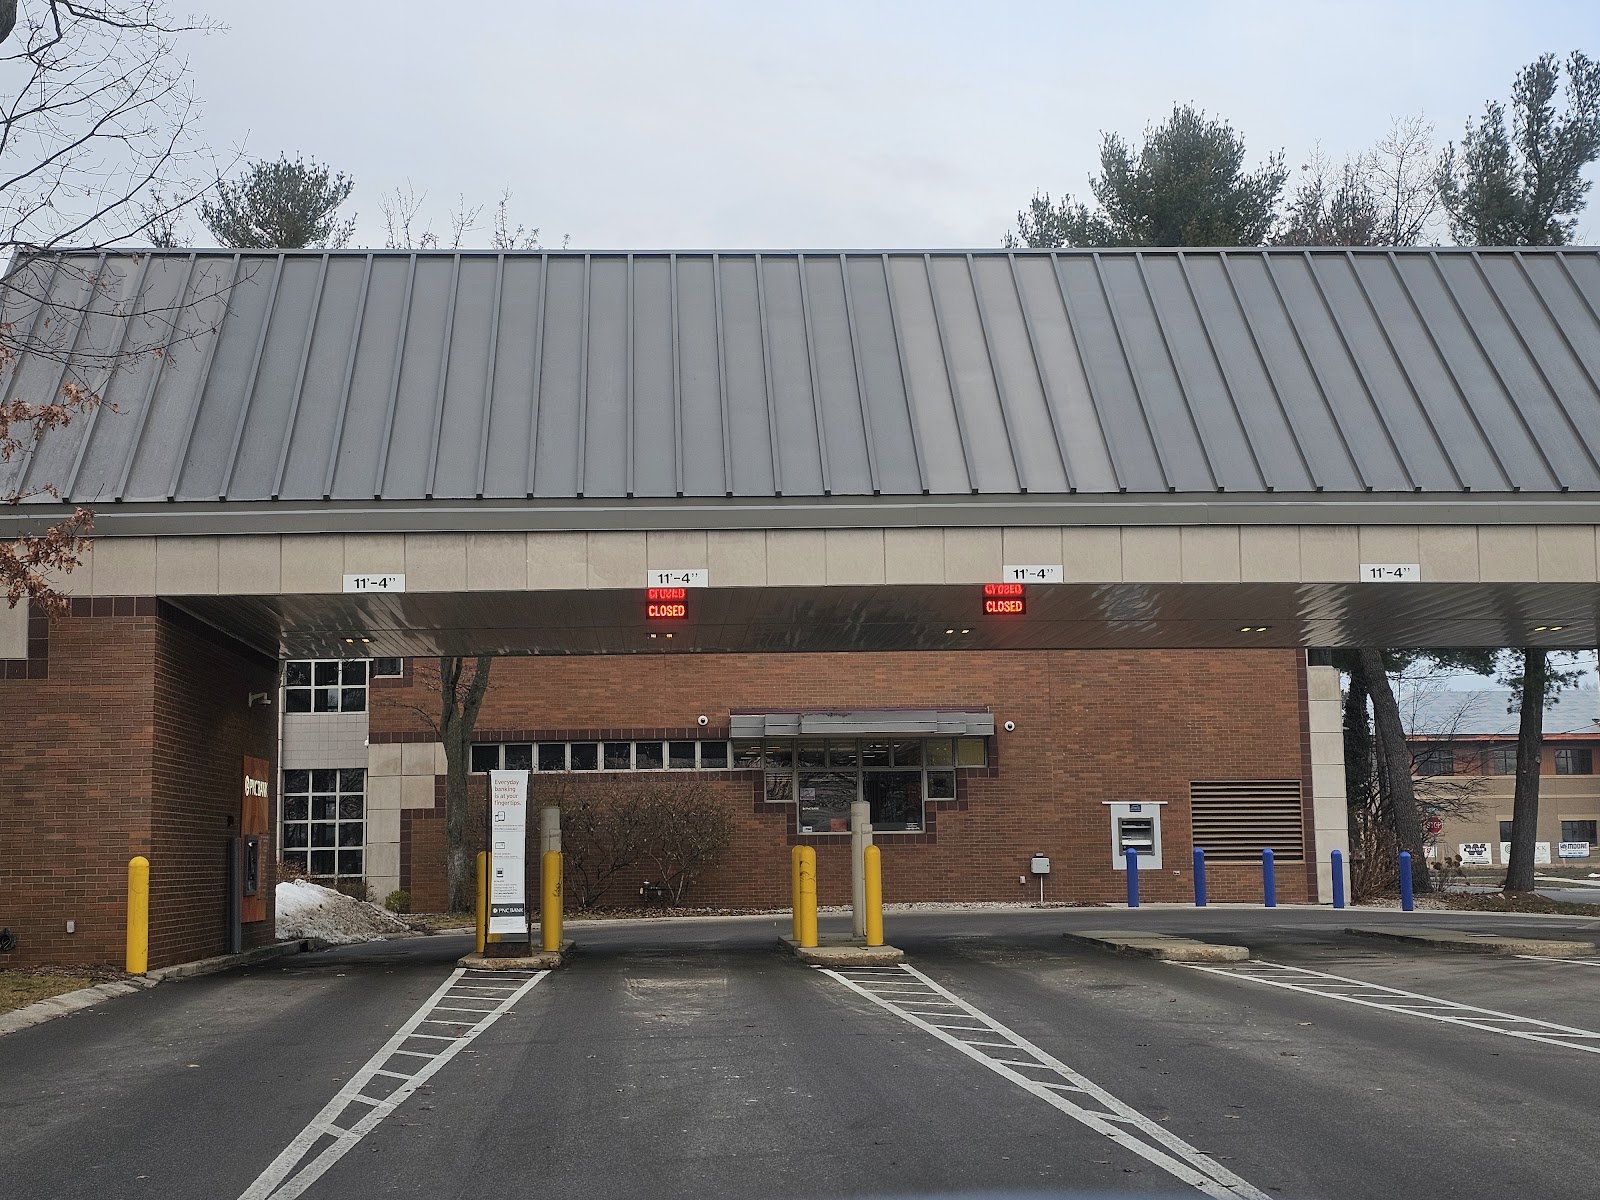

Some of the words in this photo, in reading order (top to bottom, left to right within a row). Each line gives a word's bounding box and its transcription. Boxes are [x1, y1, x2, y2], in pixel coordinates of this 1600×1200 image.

[648, 604, 686, 617] CLOSED
[986, 600, 1023, 612] CLOSED
[1426, 821, 1442, 829] STOP
